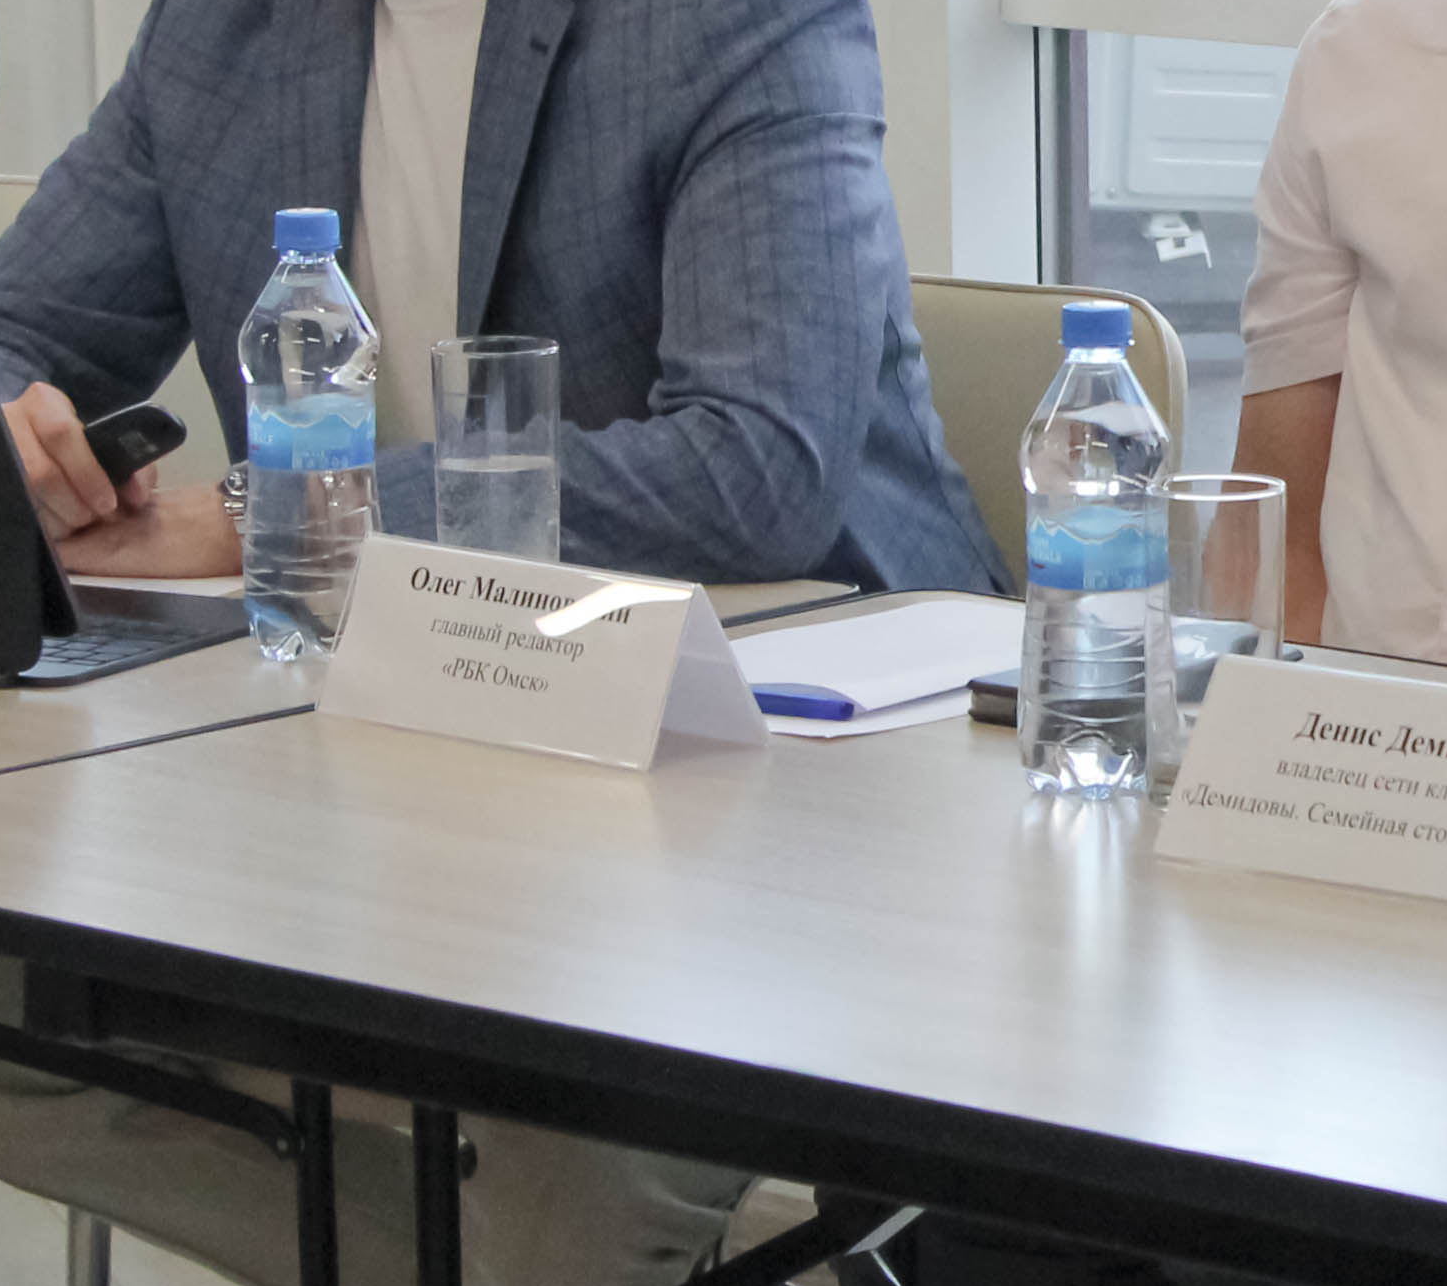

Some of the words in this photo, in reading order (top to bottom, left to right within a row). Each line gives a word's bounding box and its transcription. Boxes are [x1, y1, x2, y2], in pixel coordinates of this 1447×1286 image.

[411, 567, 466, 596] Олег
[430, 618, 503, 643] главный
[504, 631, 584, 662] редактор
[442, 658, 491, 682] «РБК
[493, 665, 549, 692] Омск»
[1293, 712, 1382, 747] Денис
[1276, 760, 1369, 790] владелец
[1373, 774, 1420, 796] сети
[1181, 782, 1299, 821] «Демидовы.
[1308, 802, 1408, 837] Семейная
